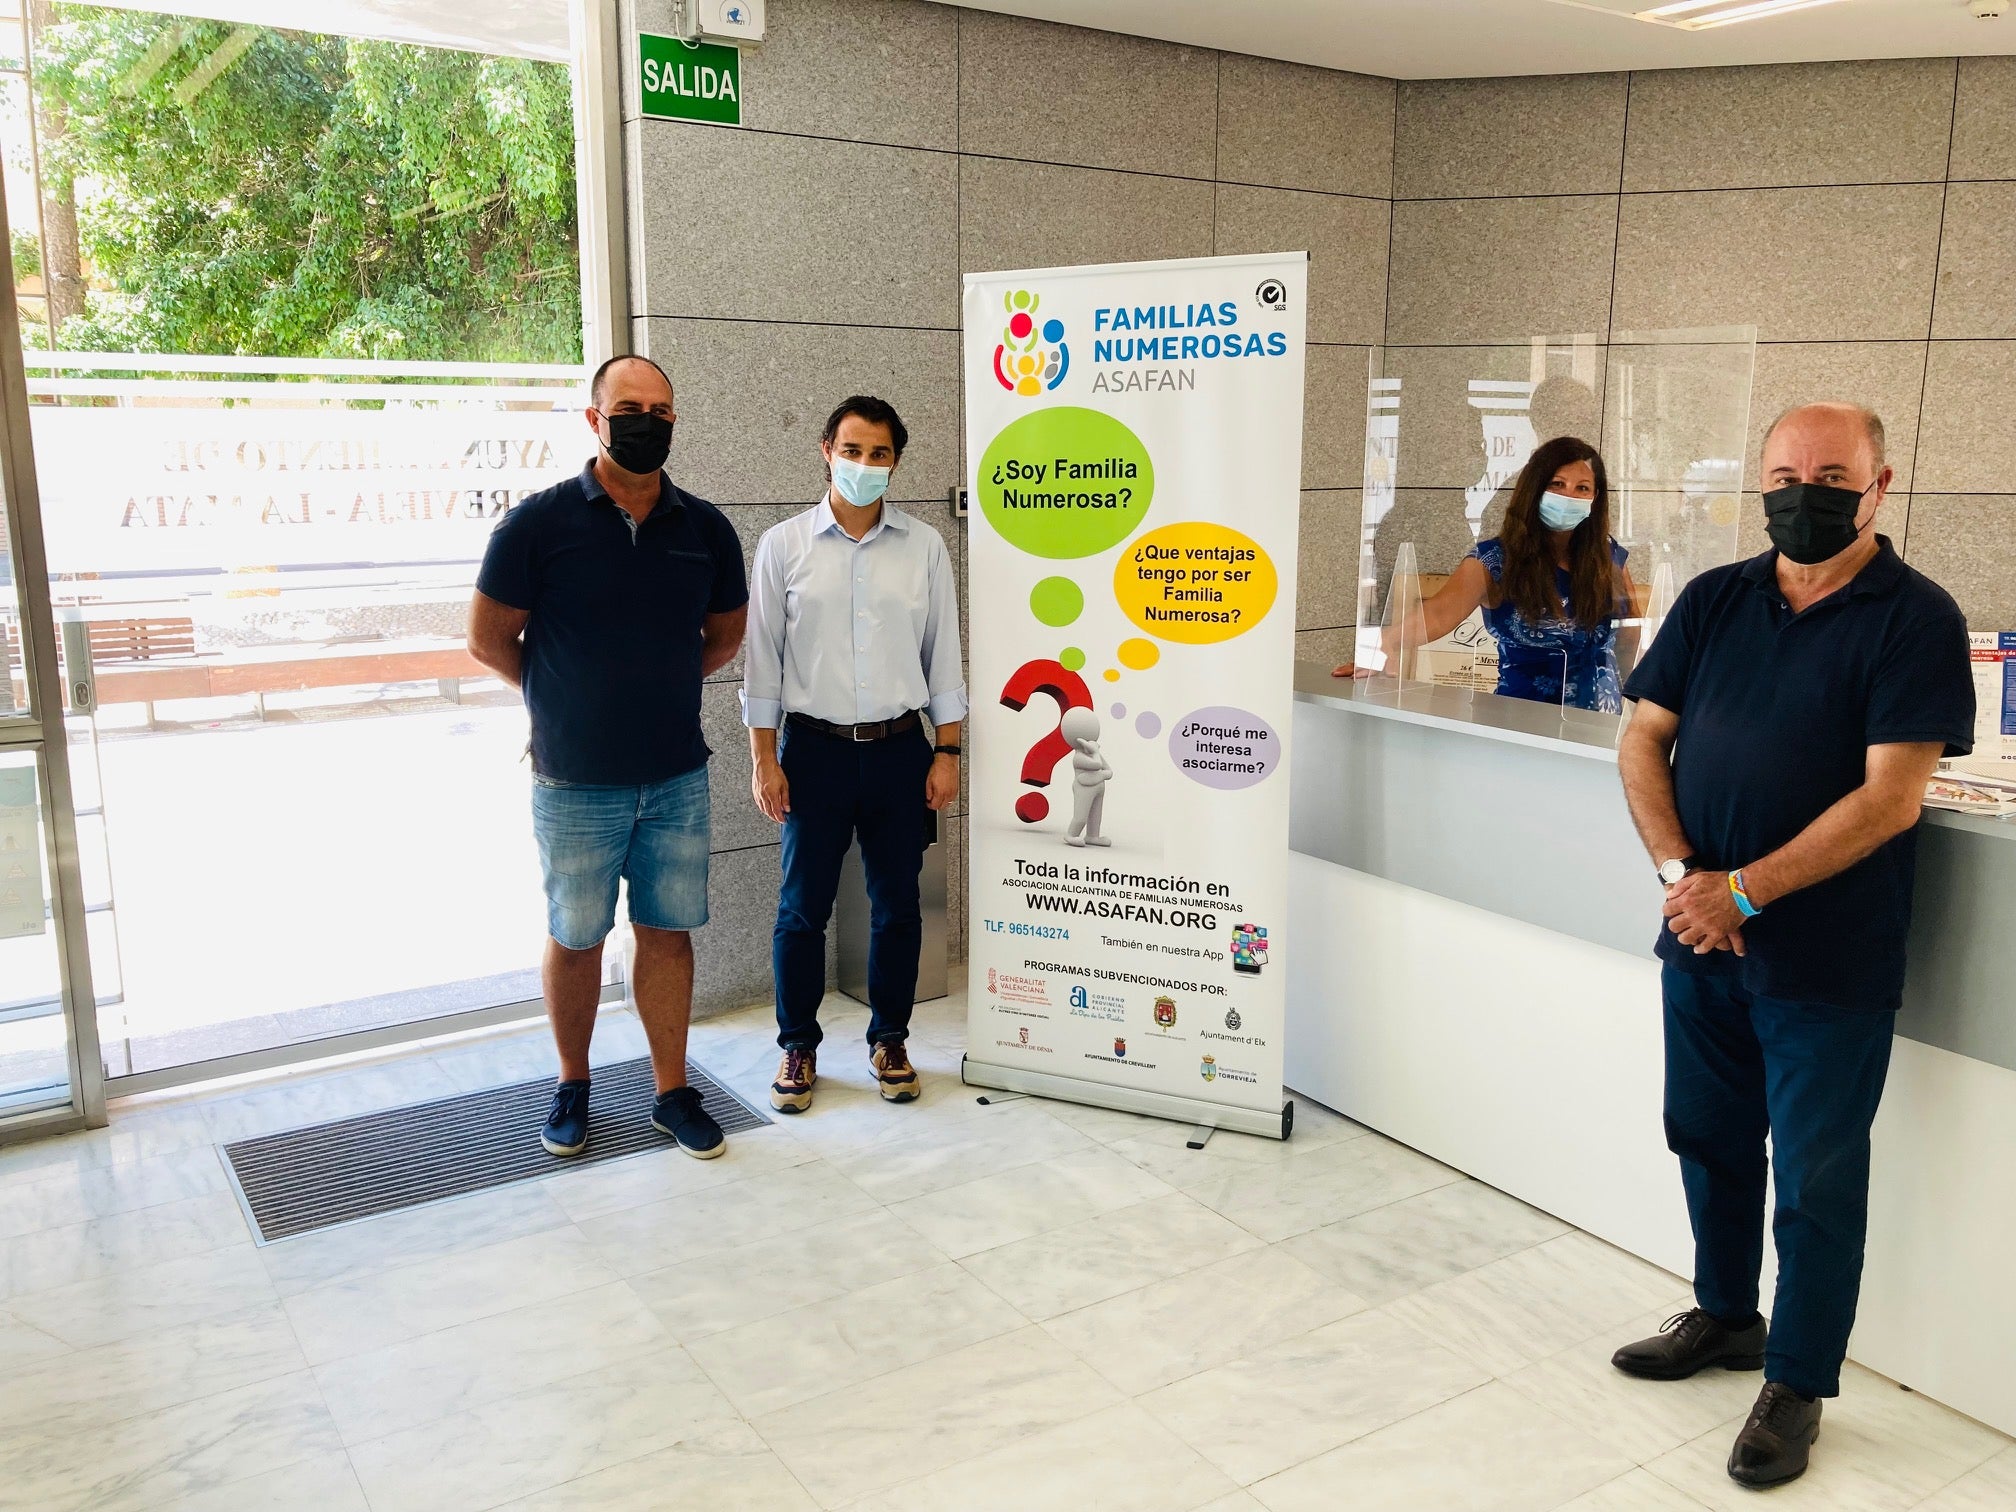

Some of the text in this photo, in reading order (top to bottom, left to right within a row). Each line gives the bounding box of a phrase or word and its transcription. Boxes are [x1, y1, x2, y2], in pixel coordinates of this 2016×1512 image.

[643, 58, 737, 103] SALIDA
[1094, 302, 1238, 332] FAMILIAS
[1094, 332, 1287, 363] NUMEROSAS
[1092, 368, 1195, 393] ASAFAN
[992, 458, 1138, 485] ¿Soy Familia
[1003, 488, 1132, 509] Numerosa?
[1134, 545, 1256, 564] ¿Que ventajas
[1138, 566, 1252, 584] tengo por ser
[1164, 586, 1223, 602] Familia
[1145, 607, 1241, 623] Numerosa?
[1182, 723, 1268, 740] ¿Porqué me
[1196, 741, 1252, 756] interesa
[1183, 759, 1265, 774] asociarme?
[1014, 859, 1230, 897] Toda la información en
[1002, 878, 1243, 912] ASOCIACION ALICANTINA DE FAMILIAS NUMEROSAS
[1026, 893, 1216, 930] WWW.ASAFAN.ORG
[984, 920, 1070, 940] TLF. 965143274
[1101, 936, 1224, 961] También en nuestra App
[1000, 975, 1046, 986] GENERALITAT
[1024, 960, 1228, 996] PROGRAMAS SUBVENCIONADOS POR:
[1000, 982, 1045, 994] VALENCIANA
[1200, 1030, 1245, 1044] Ajuntament
[1084, 1053, 1121, 1064] AYUNTAMIENTO
[1128, 1060, 1156, 1069] CREVILLENT
[1218, 1072, 1257, 1084] TORREVIEJA
